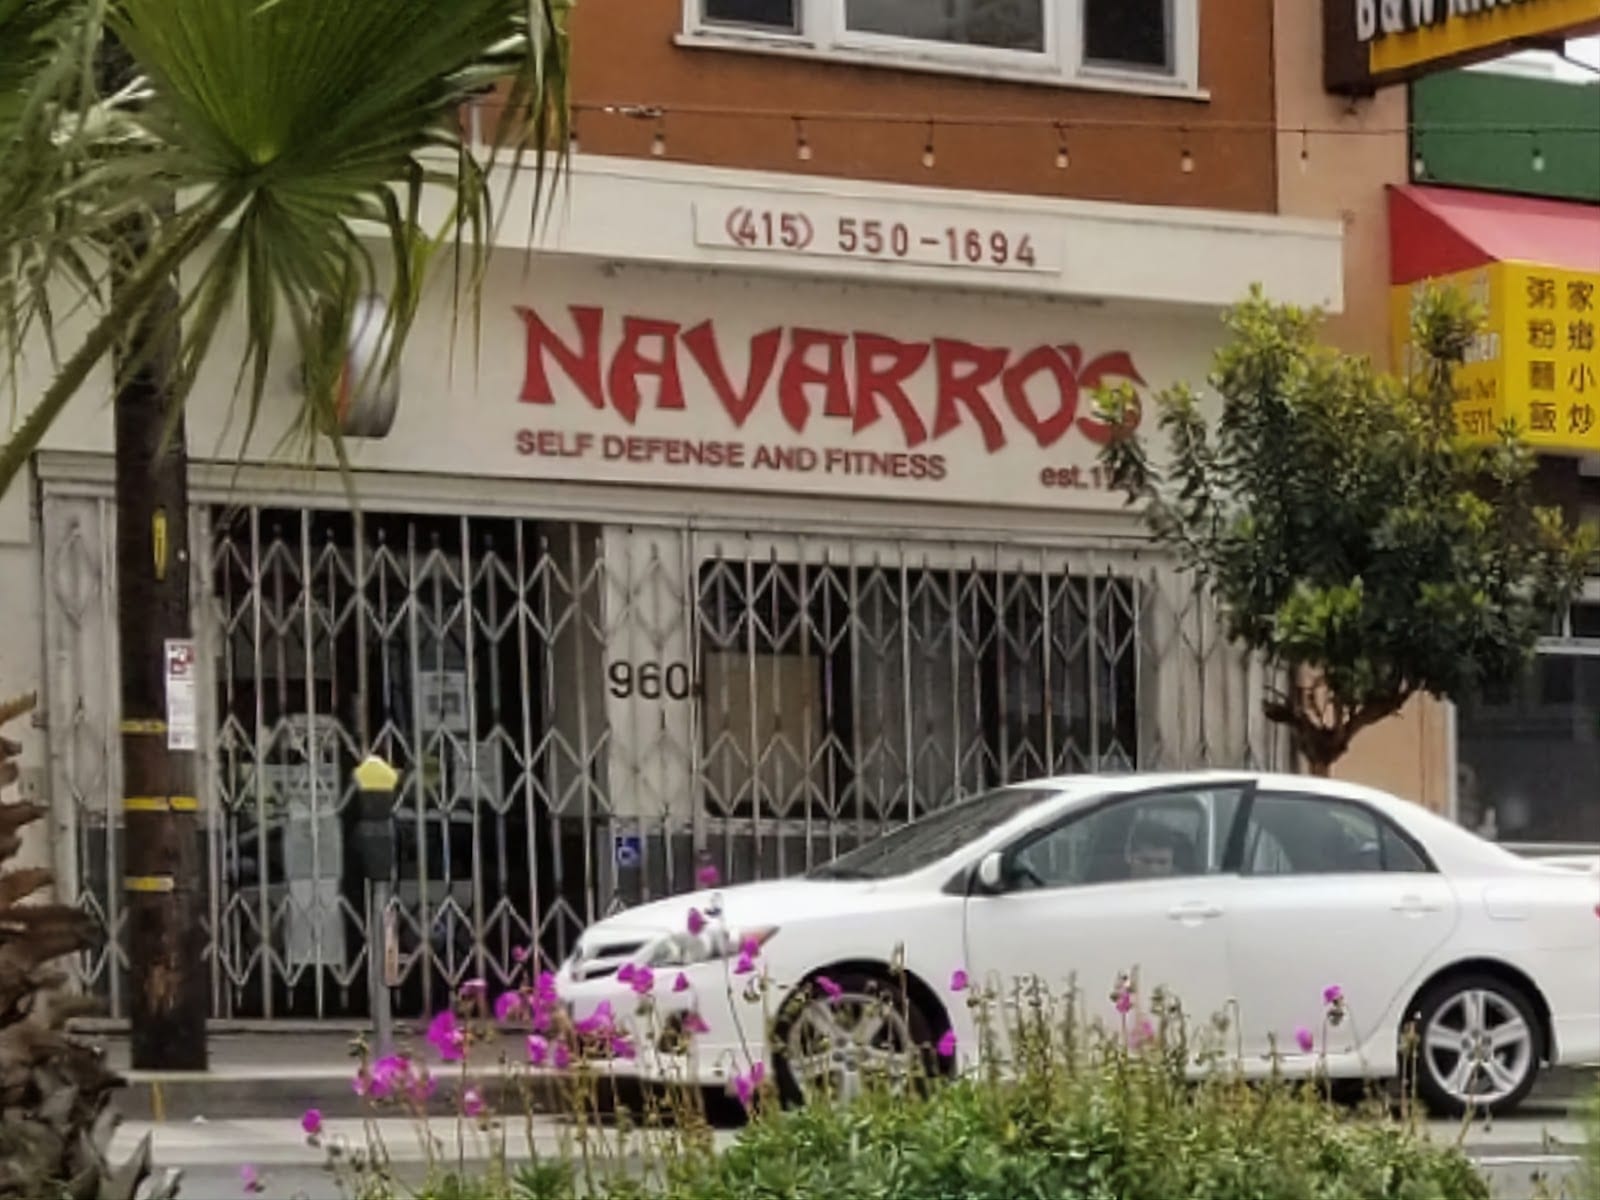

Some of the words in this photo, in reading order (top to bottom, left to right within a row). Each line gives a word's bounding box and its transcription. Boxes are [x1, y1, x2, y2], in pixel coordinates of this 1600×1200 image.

[726, 206, 814, 248] (415)
[837, 216, 1037, 267] 550-1694
[512, 304, 1147, 454] NAVARRO'S
[515, 429, 594, 457] SELF
[603, 434, 744, 468] DEFENSE
[752, 445, 817, 472] AND
[825, 447, 946, 480] FITNESS
[608, 661, 689, 700] 960
